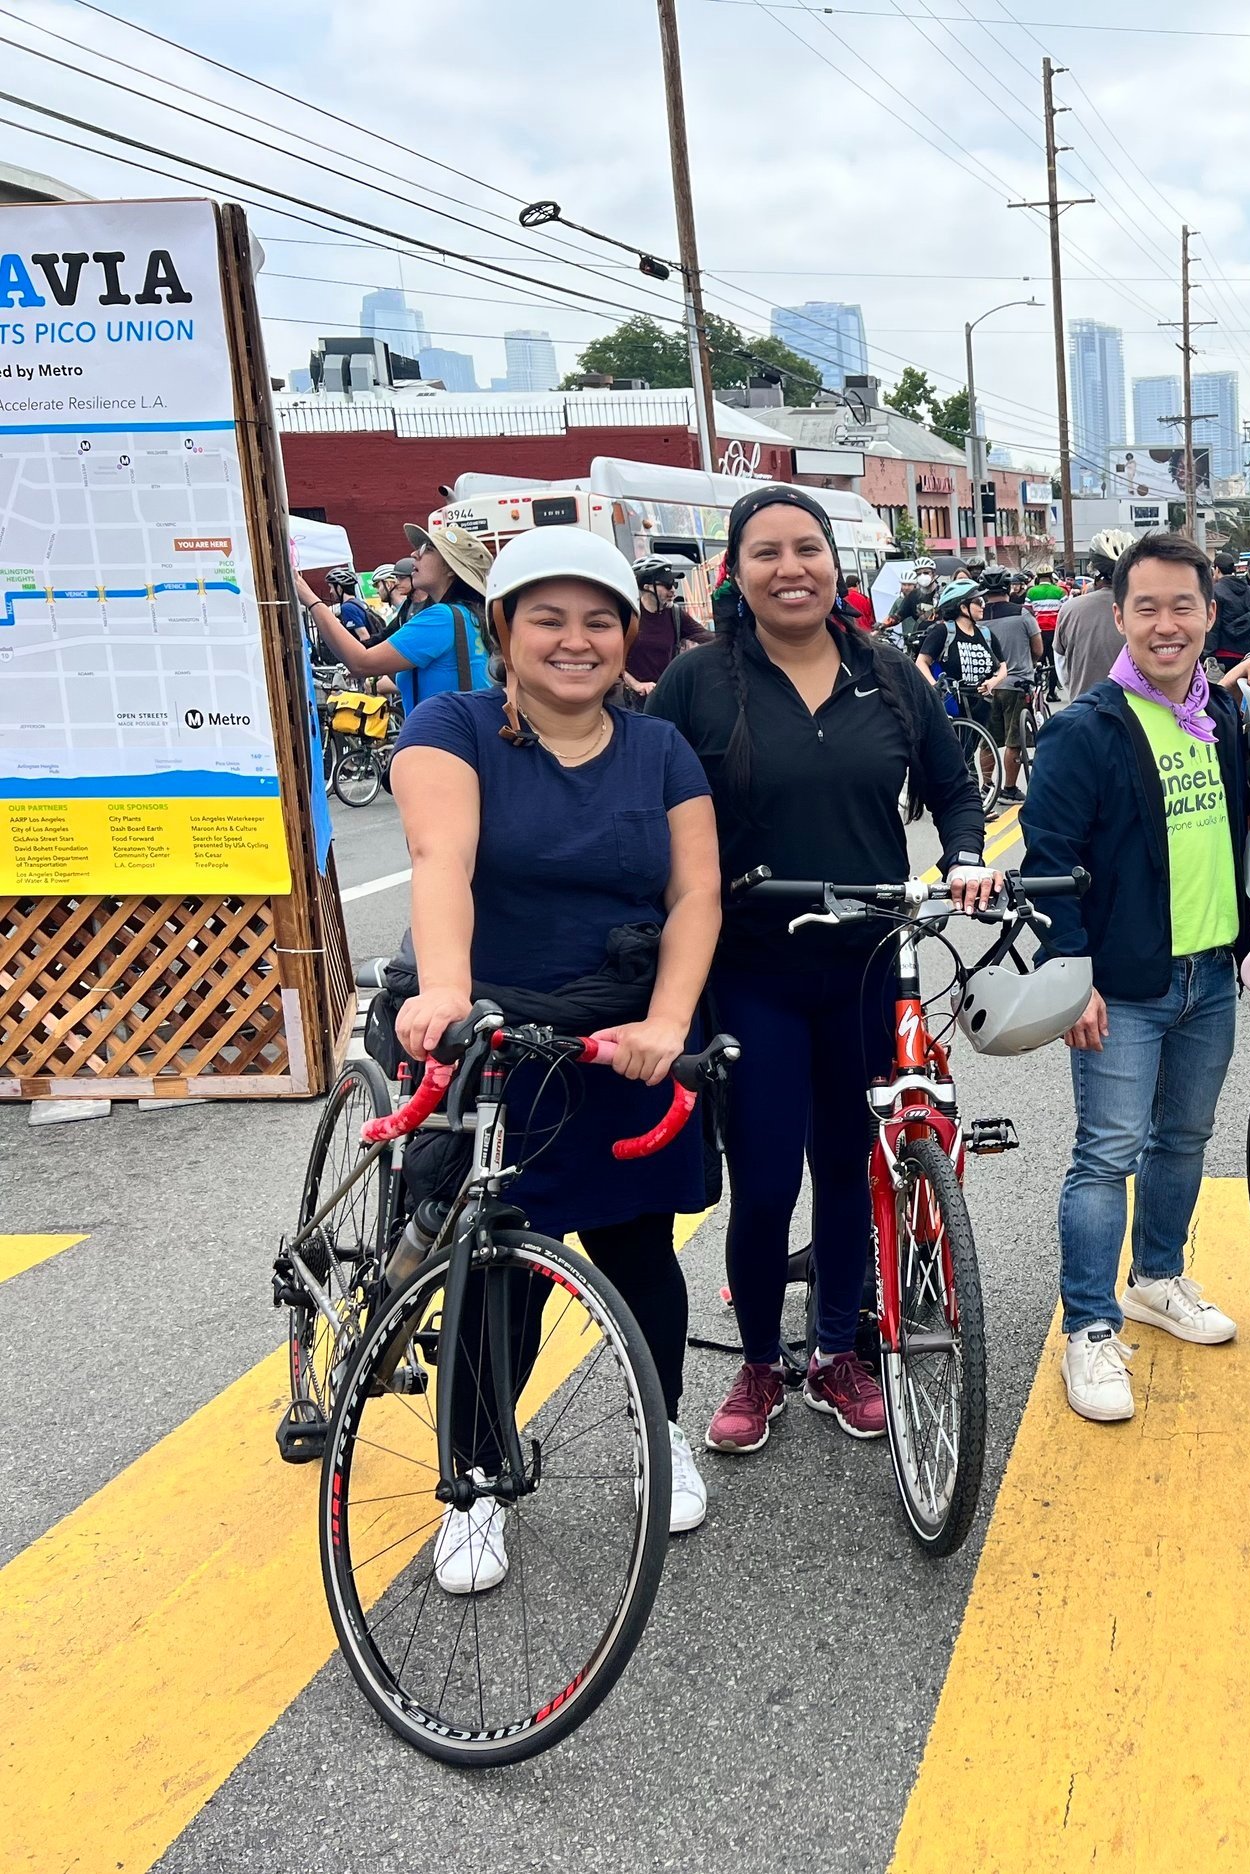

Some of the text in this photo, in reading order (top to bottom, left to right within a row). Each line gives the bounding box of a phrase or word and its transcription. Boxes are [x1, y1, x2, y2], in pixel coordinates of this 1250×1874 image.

[36, 322, 96, 343] PICO
[107, 319, 193, 342] UNION
[0, 364, 83, 381] d by Metro
[69, 395, 136, 409] Resilience
[141, 395, 168, 408] L.A.
[447, 508, 474, 521] 3944
[211, 540, 228, 548] HERE
[209, 713, 251, 726] Metro
[1159, 752, 1184, 771] OS
[41, 816, 66, 824] Angeles
[544, 1249, 587, 1284] ZAFFIRO
[385, 1690, 532, 1742] RITCHEY
